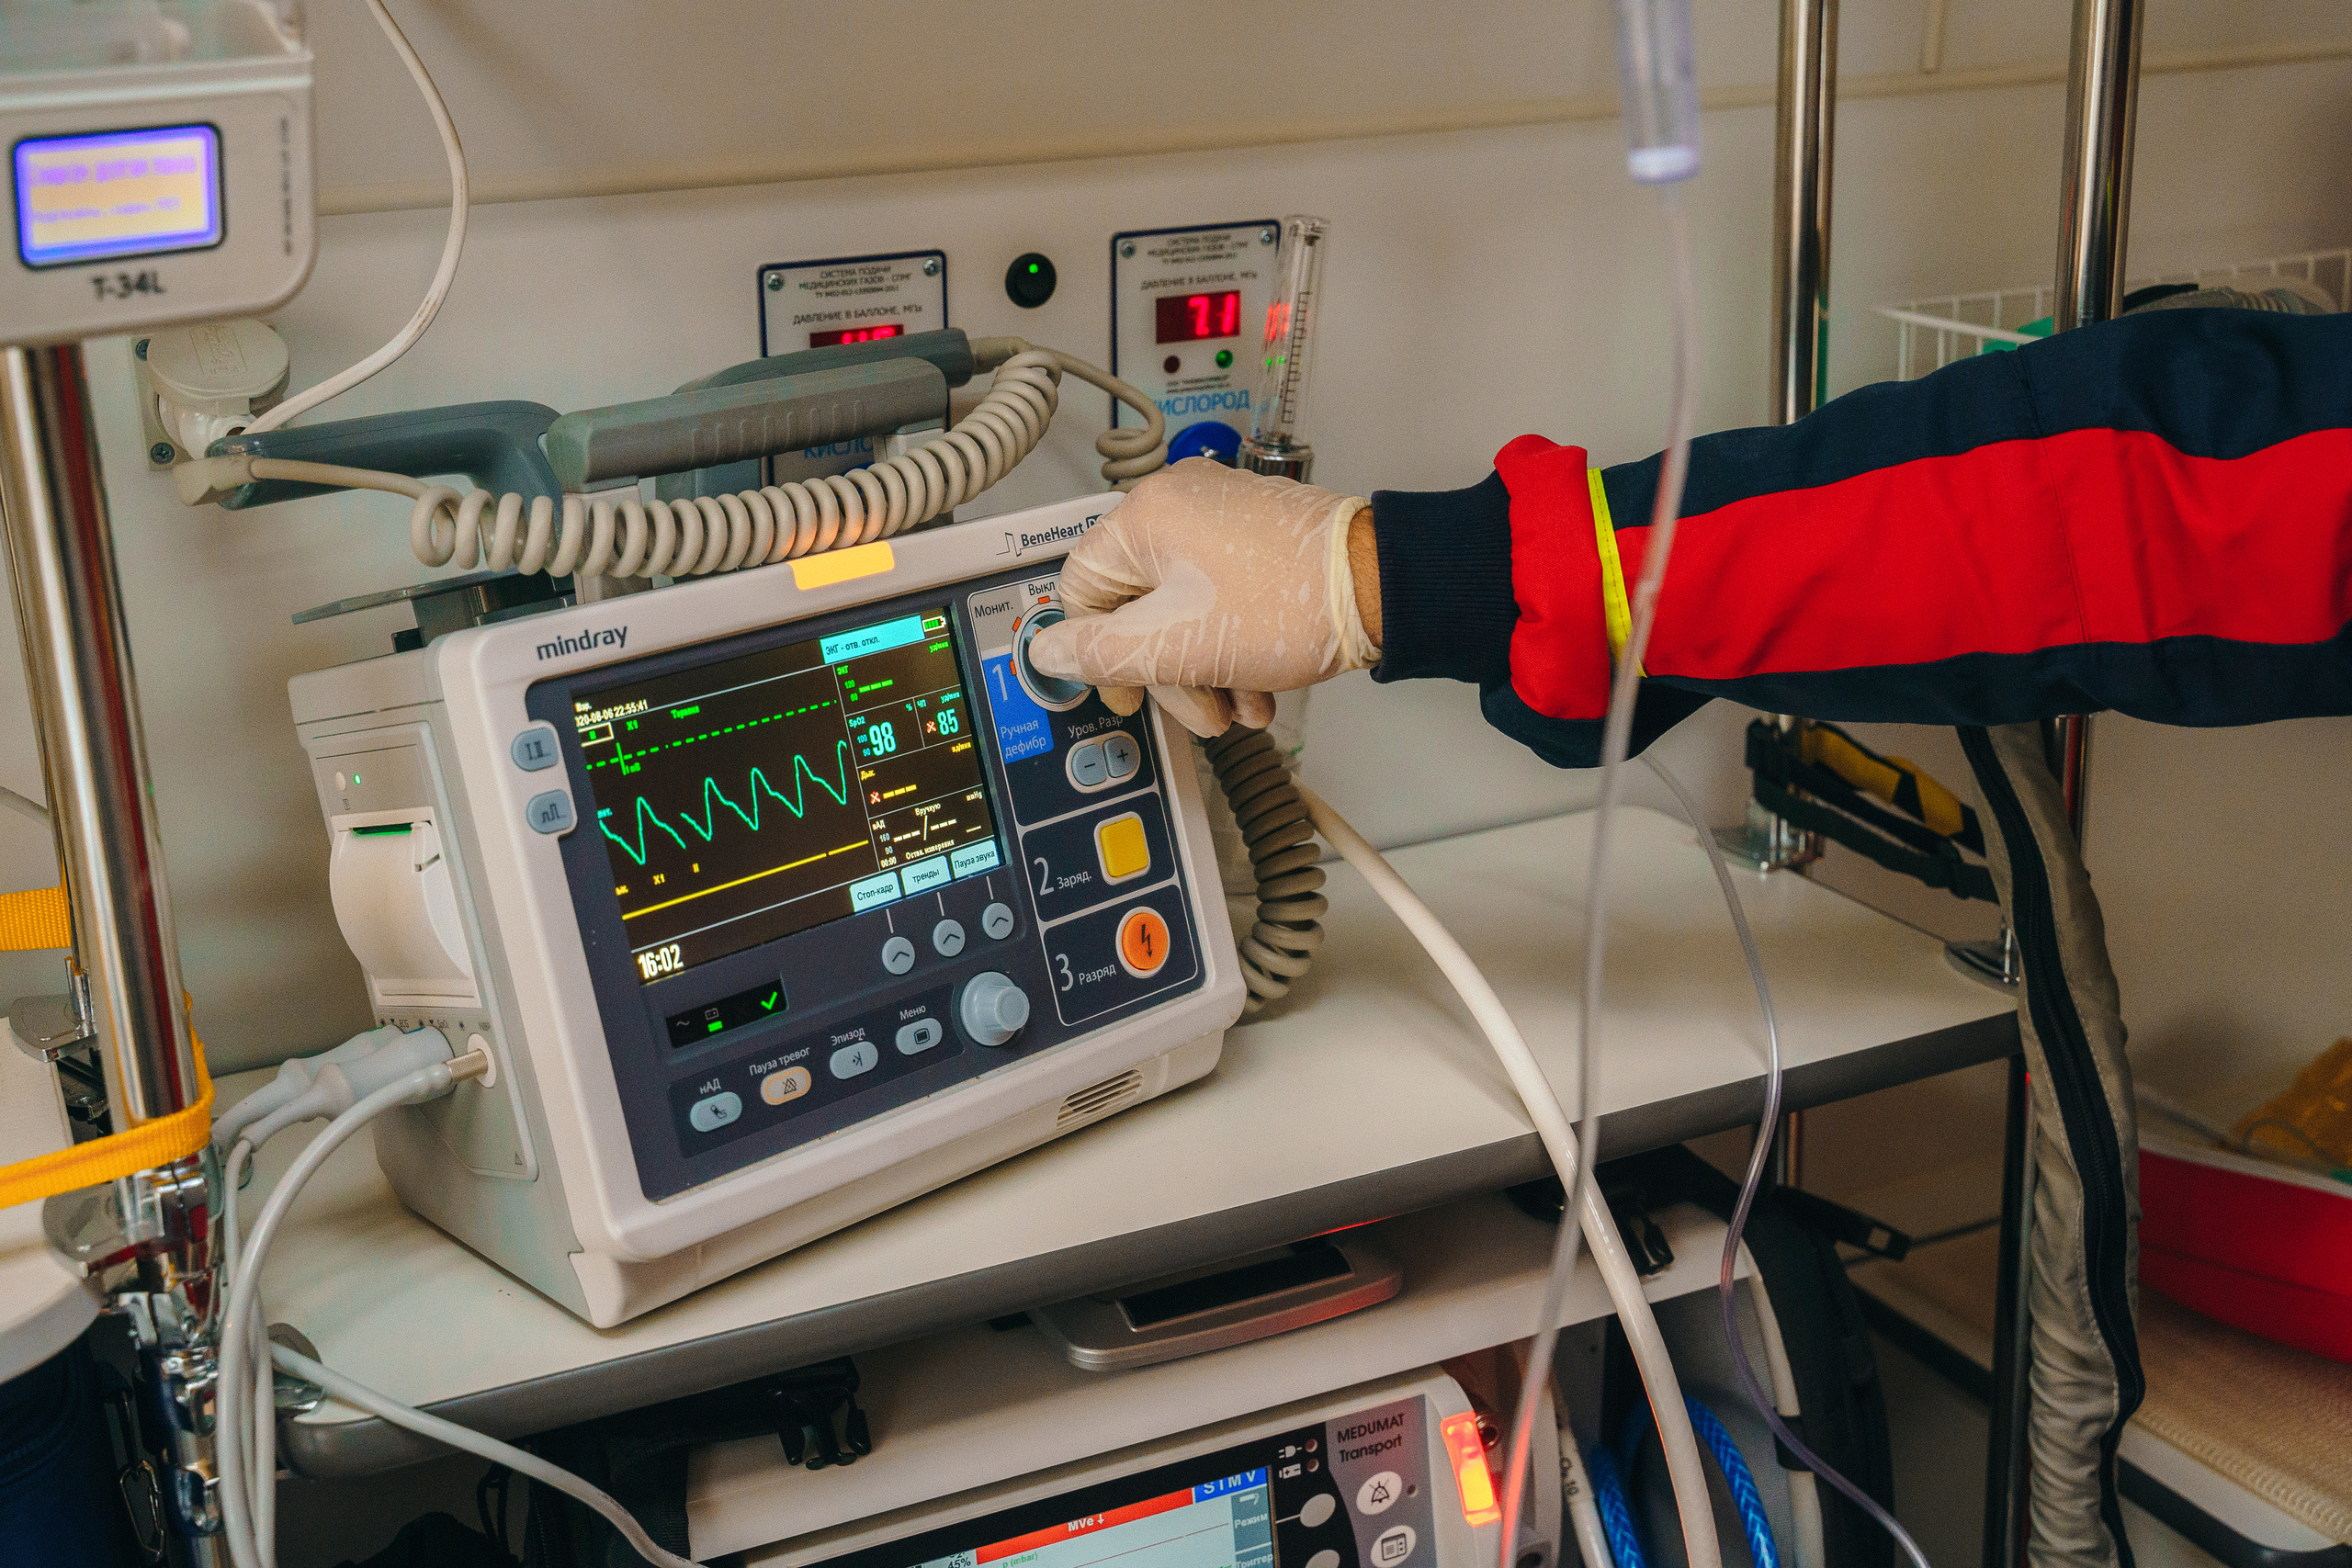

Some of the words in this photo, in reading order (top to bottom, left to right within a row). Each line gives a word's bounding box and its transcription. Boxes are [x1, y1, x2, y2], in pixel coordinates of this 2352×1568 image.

[820, 268, 856, 279] СИСТЕМА
[92, 270, 166, 300] T-34L
[798, 278, 858, 290] МЕДИЦИНСКИХ
[793, 311, 842, 326] ДАВЛЕНИЕ
[844, 309, 852, 319] В
[1155, 389, 1250, 416] ИСЛОРОД
[1021, 522, 1084, 547] BeneHeart
[1028, 581, 1056, 596] Выкл
[974, 600, 1013, 618] Монит.
[537, 626, 628, 660] mindray
[825, 644, 839, 656] ЭКГ
[845, 641, 861, 651] отв.
[861, 637, 880, 647] откл.
[836, 664, 849, 675] ЭКГ
[844, 679, 855, 689] 120
[992, 663, 1009, 702] 1
[614, 699, 648, 717] 22:55:41
[905, 703, 913, 712] %
[848, 716, 866, 728] SpO2
[936, 708, 959, 736] 85
[1000, 719, 1039, 740] Ручная
[856, 734, 868, 744] 100
[868, 721, 897, 756] 98
[1068, 723, 1098, 739] Уров.
[862, 748, 871, 757] 90
[1005, 736, 1046, 759] дефибр
[914, 803, 941, 816] Вручную
[879, 832, 890, 842] 160
[885, 845, 893, 855] 90
[880, 856, 898, 868] 00:00
[955, 857, 975, 870] Пауза
[976, 850, 995, 863] звука
[653, 874, 665, 886] X1
[912, 869, 940, 884] тренды
[1034, 857, 1055, 897] 2
[1057, 871, 1092, 889] Заряд.
[857, 883, 894, 901] Стоп-кадр
[638, 943, 684, 979] 16:02
[1056, 953, 1074, 992] 3
[1079, 964, 1116, 985] Разряд
[899, 1004, 926, 1021] Меню
[399, 1019, 410, 1029] ECG
[831, 1027, 865, 1046] Эпизод
[749, 1056, 778, 1077] Пауза
[779, 1046, 810, 1066] тревог
[699, 1077, 721, 1095] нАД
[1337, 1414, 1405, 1443] MEDUMAT
[1339, 1434, 1403, 1463] Transport
[1068, 1519, 1094, 1532] MVe
[1234, 1513, 1268, 1529] Режим
[1011, 1551, 1038, 1567] (mbar)
